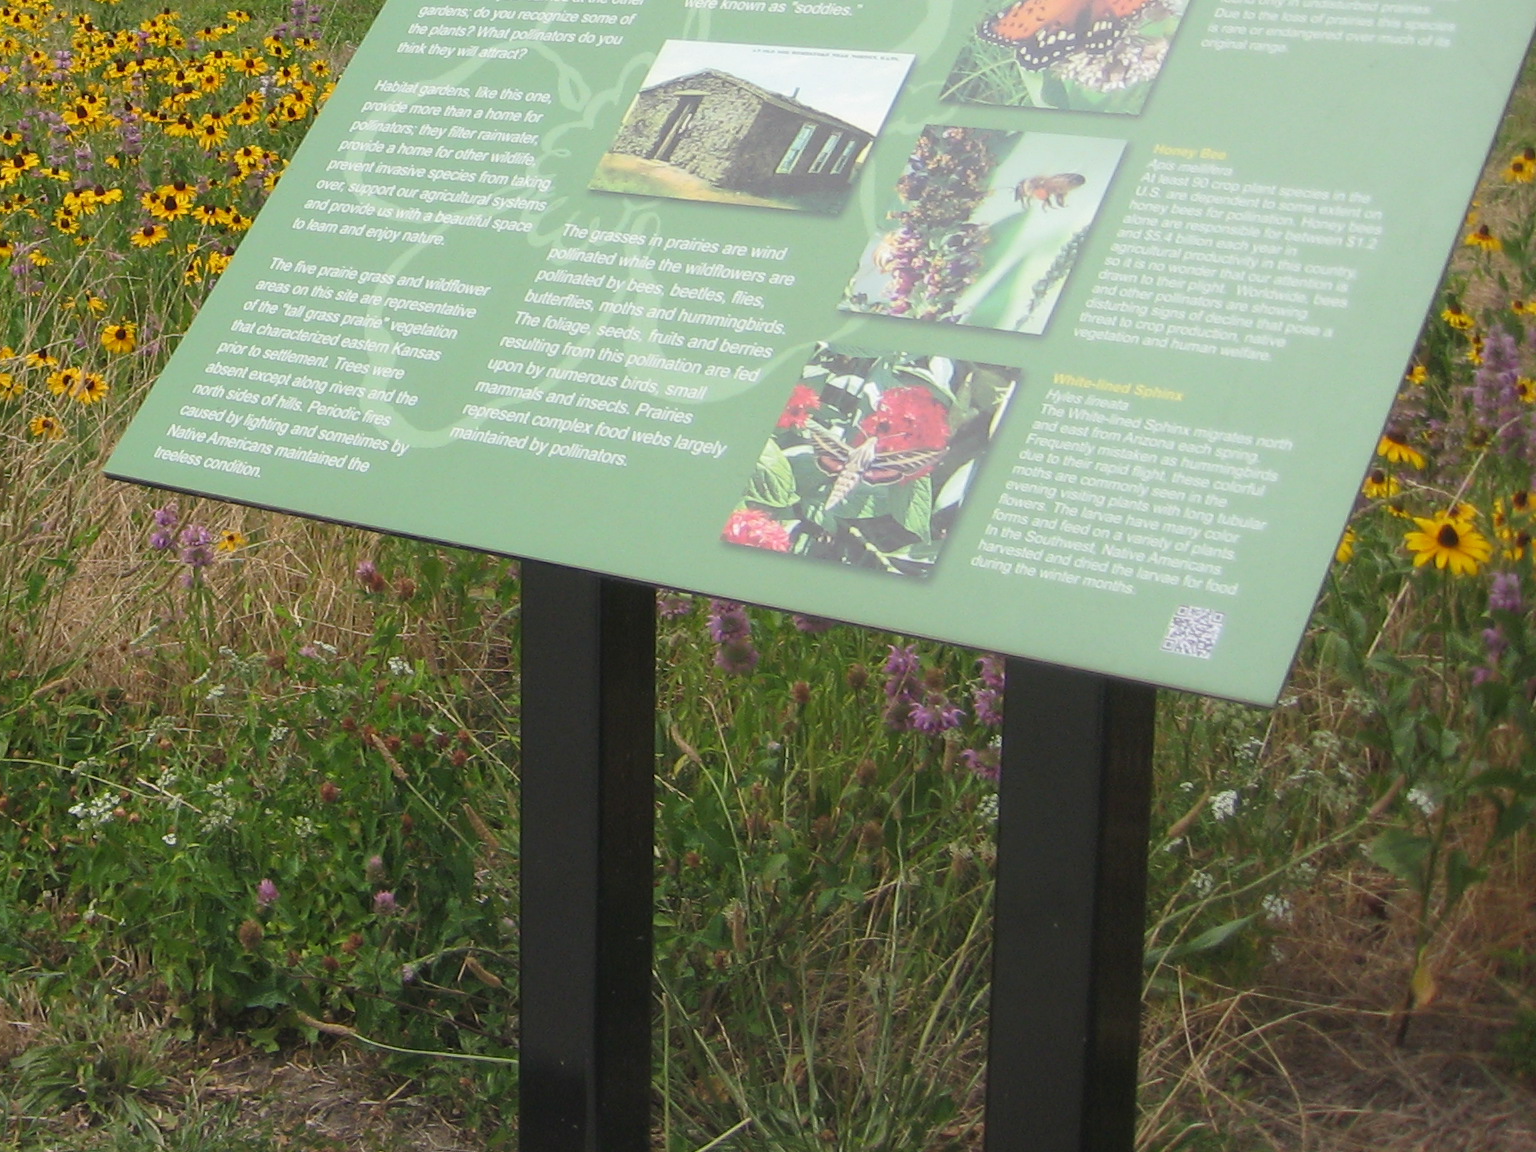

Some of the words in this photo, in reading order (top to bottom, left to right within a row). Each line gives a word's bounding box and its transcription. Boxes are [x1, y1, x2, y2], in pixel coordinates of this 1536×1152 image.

[684, 0, 717, 10] were
[768, 3, 786, 13] as
[374, 77, 420, 94] Habitat
[475, 83, 498, 99] like
[499, 85, 523, 101] this
[361, 99, 407, 116] provide
[409, 105, 441, 116] more
[443, 102, 472, 118] than
[473, 108, 483, 119] a
[485, 105, 522, 121] home
[524, 107, 543, 122] for
[418, 121, 446, 141] they
[448, 123, 475, 139] filter
[563, 222, 587, 240] The
[587, 229, 645, 246] grasses
[649, 231, 662, 247] in
[663, 235, 719, 253] prairies
[722, 243, 748, 256] are
[750, 242, 788, 260] wind
[271, 256, 292, 273] The
[293, 258, 316, 276] five
[316, 263, 357, 281] prairie
[357, 271, 394, 285] grass
[397, 272, 425, 288] and
[424, 275, 490, 296] wildflower
[534, 267, 605, 288] pollinated
[605, 273, 624, 294] by
[546, 246, 617, 266] pollinated
[618, 253, 655, 270] while
[658, 255, 682, 273] the
[685, 259, 766, 282] wildflowers
[769, 272, 796, 285] are
[255, 280, 290, 295] areas
[291, 285, 308, 297] on
[310, 283, 333, 300] this
[335, 286, 358, 303] site
[360, 293, 382, 306] are
[384, 296, 477, 317] representative
[599, 299, 643, 317] moths
[646, 304, 677, 320] and
[242, 297, 258, 313] of
[257, 298, 277, 315] the
[302, 309, 340, 324] grass
[390, 319, 458, 338] vegetation
[230, 317, 256, 335] that
[255, 322, 341, 346] characterized
[340, 335, 389, 353] eastern
[391, 339, 442, 360] Kansas
[216, 339, 246, 357] prior
[247, 342, 261, 358] to
[336, 355, 370, 374] Trees
[372, 364, 405, 378] were
